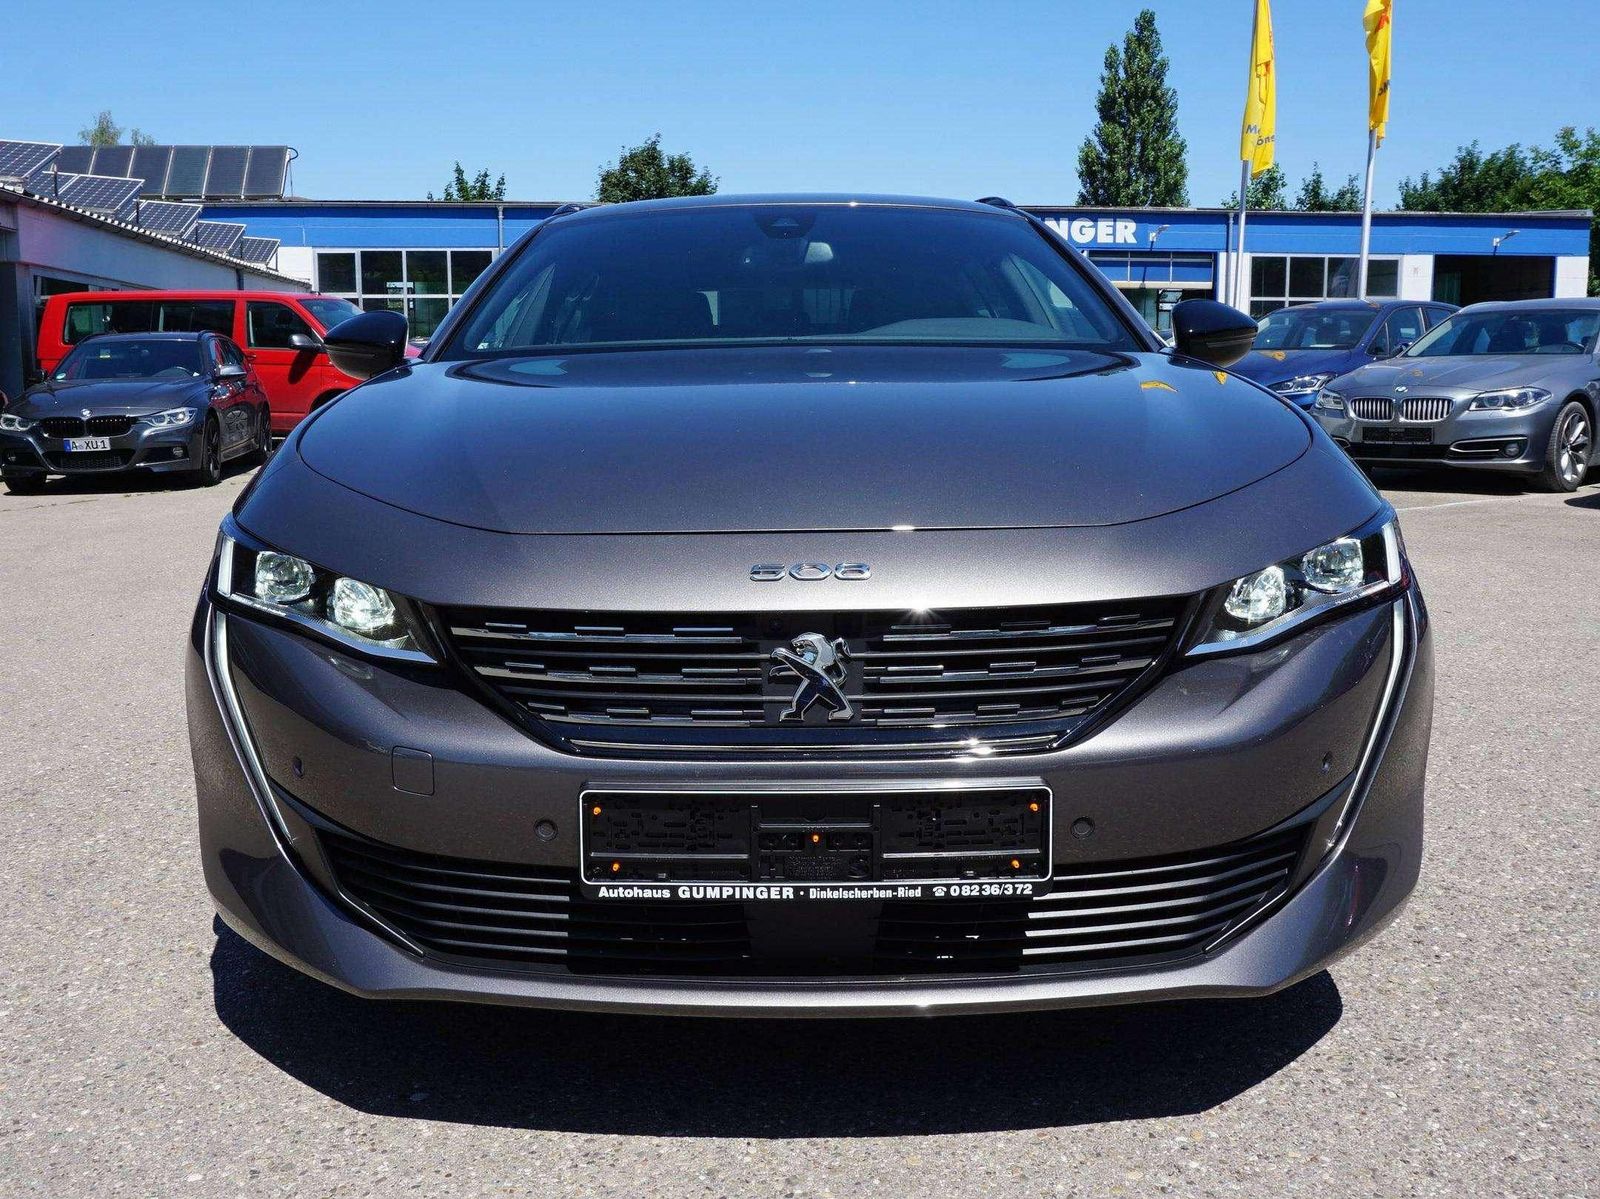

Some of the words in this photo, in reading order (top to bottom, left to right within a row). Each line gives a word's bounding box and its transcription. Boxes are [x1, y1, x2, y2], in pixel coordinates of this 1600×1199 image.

[1043, 217, 1137, 243] NGER
[749, 561, 872, 582] 508
[598, 886, 671, 899] Autohaus
[677, 885, 795, 900] GUMPINGER
[809, 885, 922, 899] Dinkelscherben-Ried
